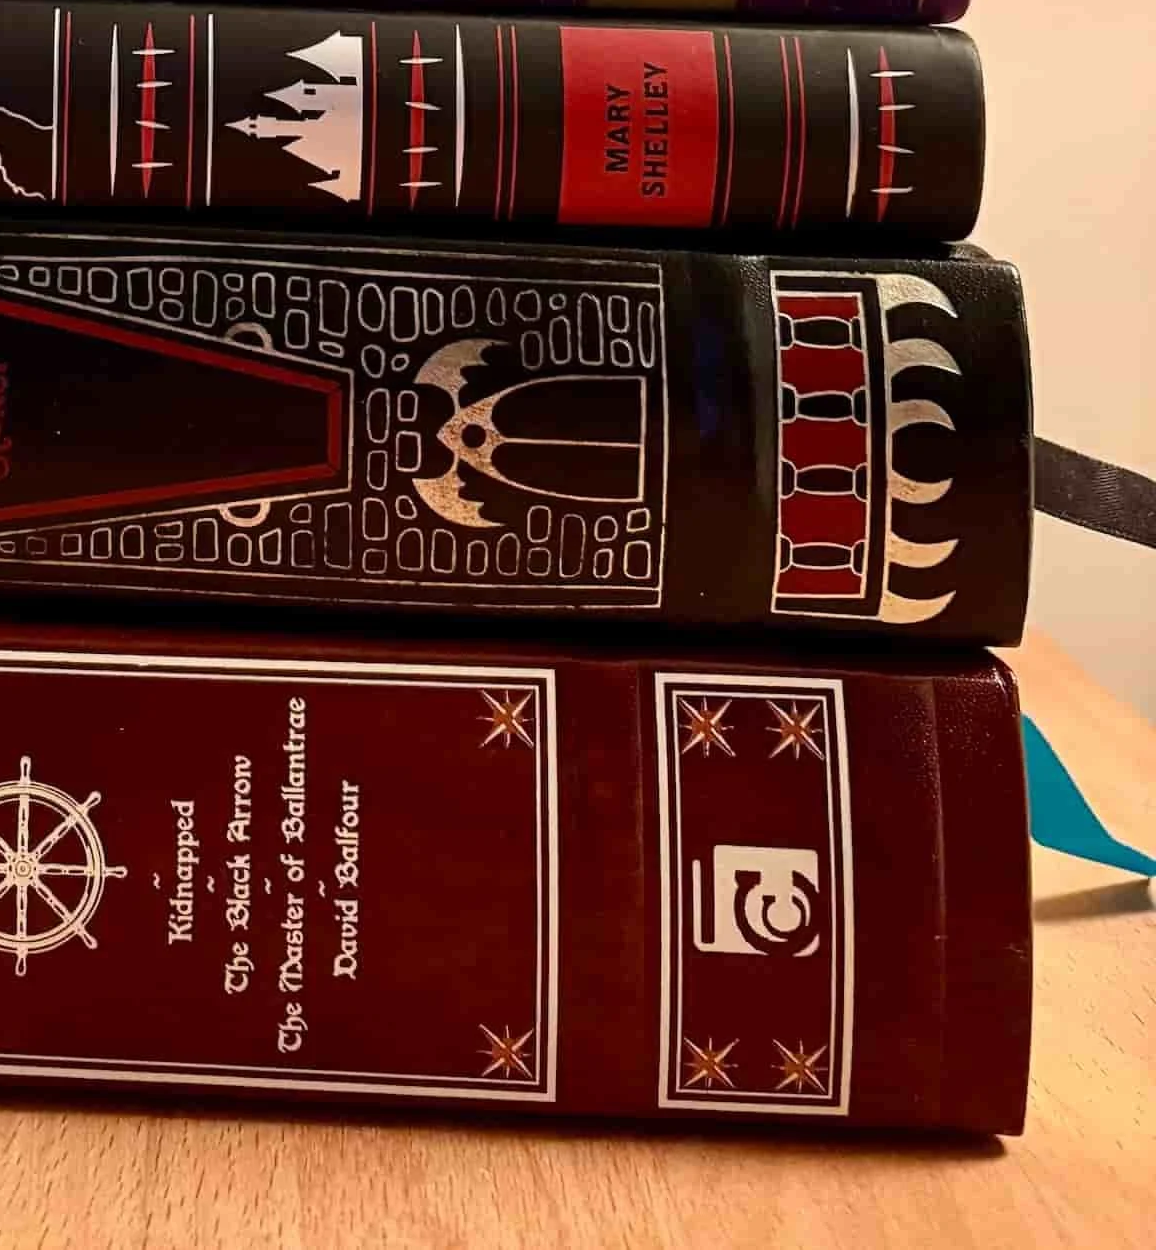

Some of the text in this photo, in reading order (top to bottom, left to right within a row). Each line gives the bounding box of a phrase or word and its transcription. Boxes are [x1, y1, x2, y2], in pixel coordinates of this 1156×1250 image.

[605, 83, 631, 174] MARY
[641, 62, 669, 198] SHELLEY
[168, 799, 199, 944] Kidnapped
[224, 755, 255, 994] The Black Arrow
[277, 697, 308, 1053] The Master of Ballantrae
[332, 780, 360, 979] David Balfour
